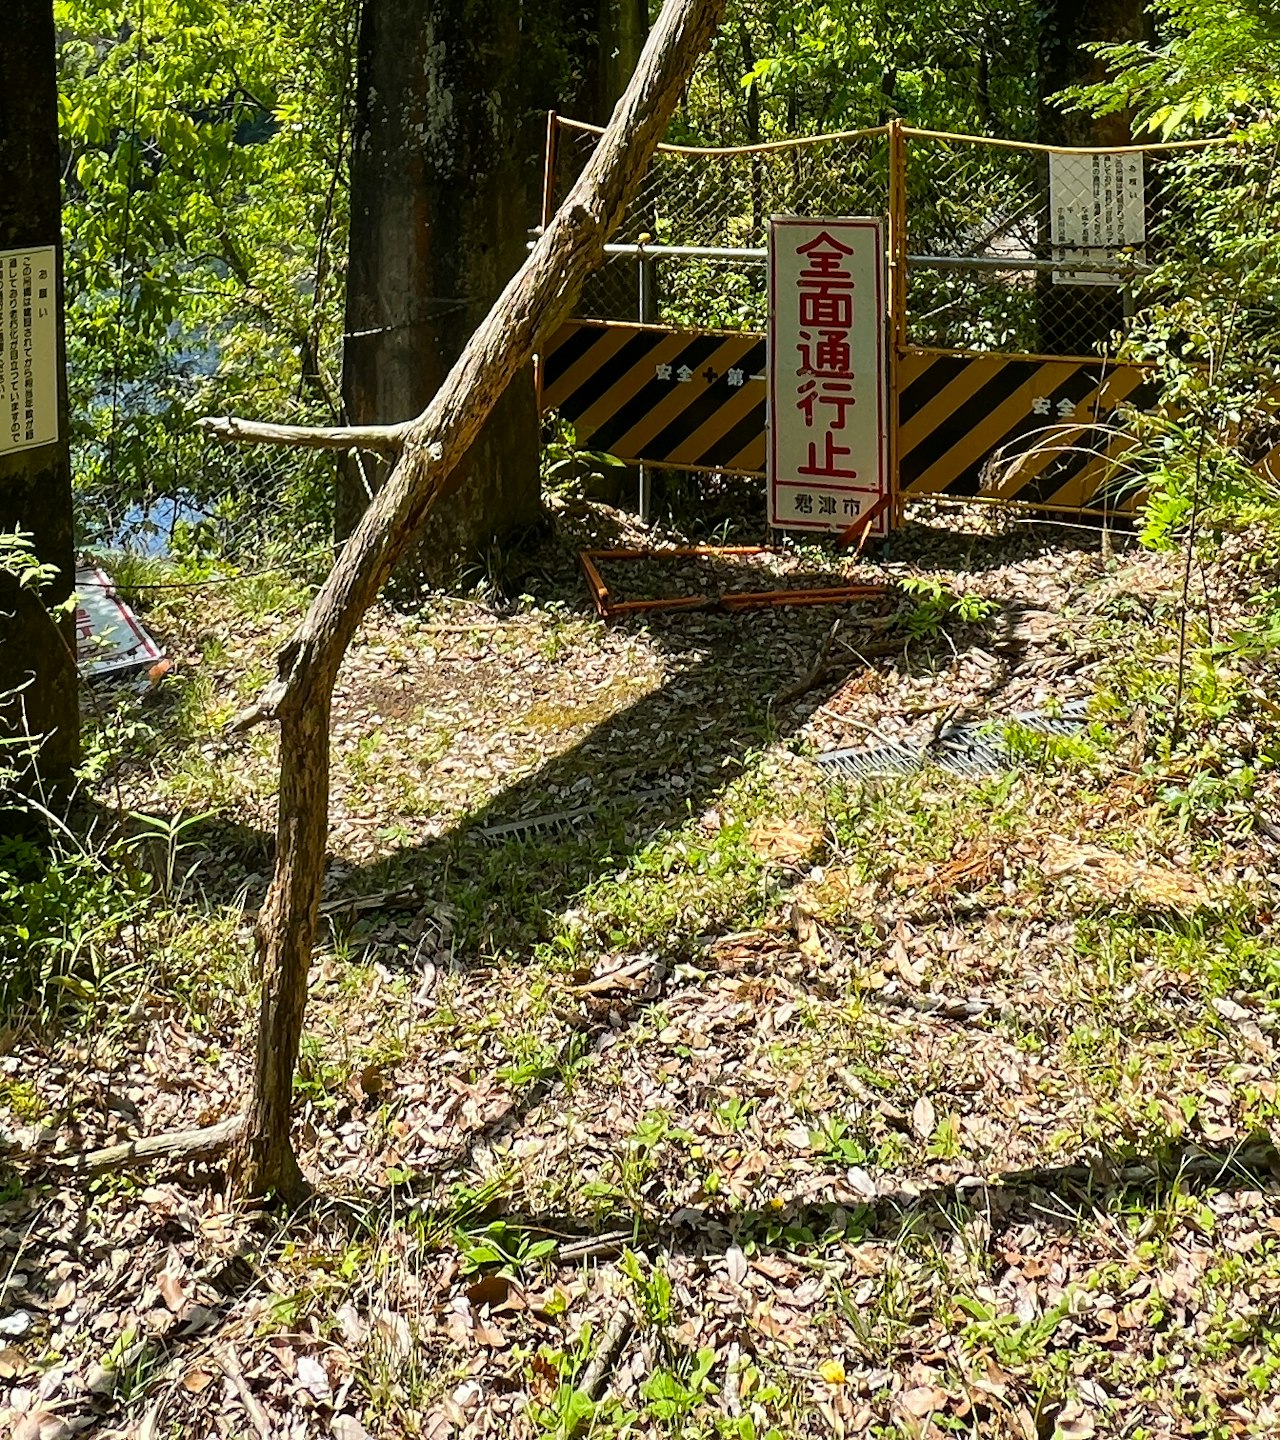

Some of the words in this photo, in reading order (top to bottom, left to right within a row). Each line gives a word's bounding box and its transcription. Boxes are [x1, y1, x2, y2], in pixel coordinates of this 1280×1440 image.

[38, 269, 48, 318] お願い
[796, 231, 857, 479] 全面通行止
[655, 363, 694, 383] 安全
[1031, 396, 1077, 417] 安全
[794, 493, 862, 517] 君津市
